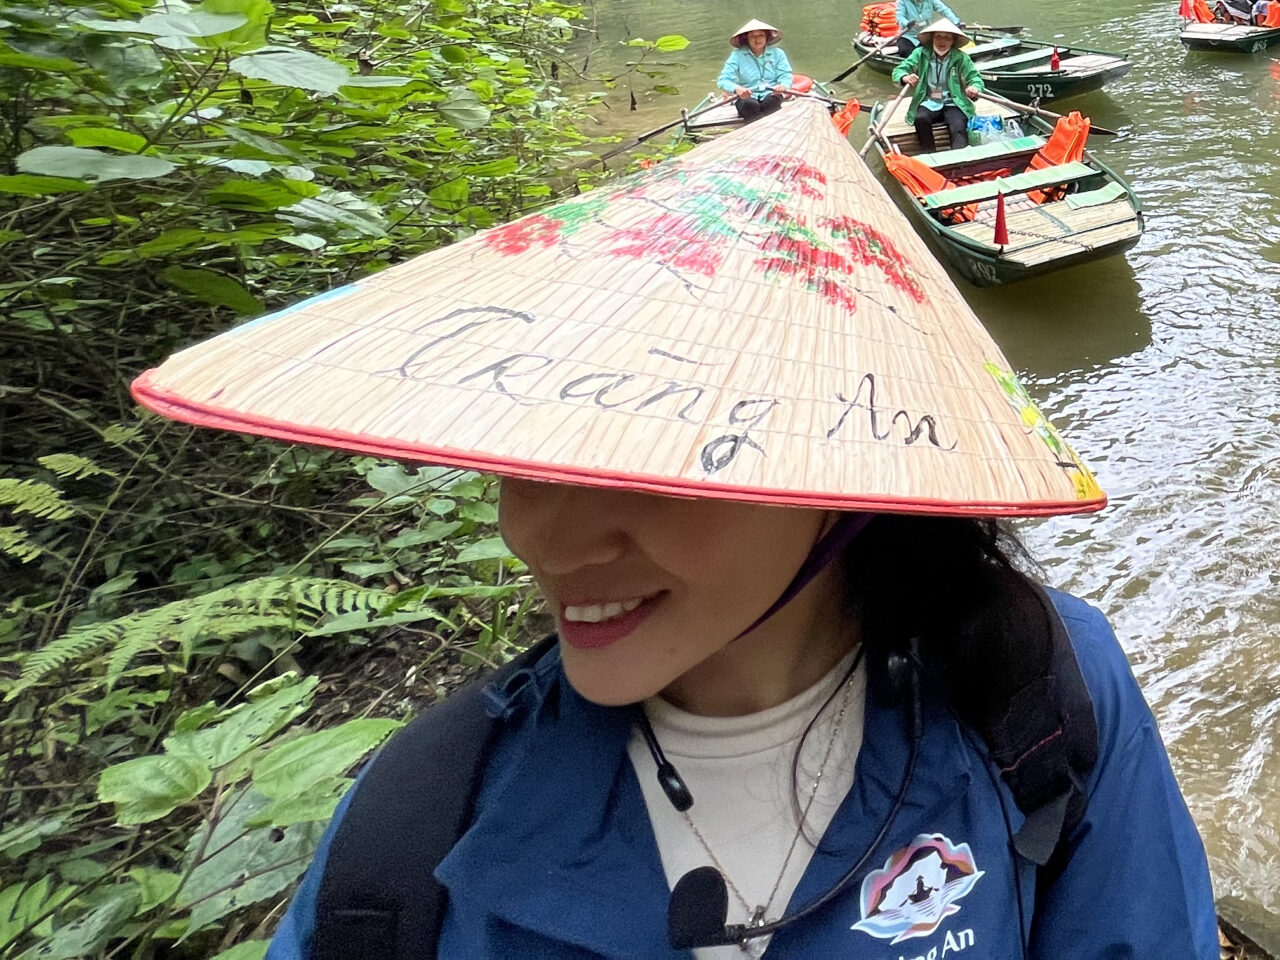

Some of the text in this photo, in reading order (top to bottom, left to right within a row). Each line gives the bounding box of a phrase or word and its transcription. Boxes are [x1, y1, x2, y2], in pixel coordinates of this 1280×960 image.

[1027, 83, 1055, 98] 272
[825, 372, 958, 452] An
[941, 928, 975, 959] An
